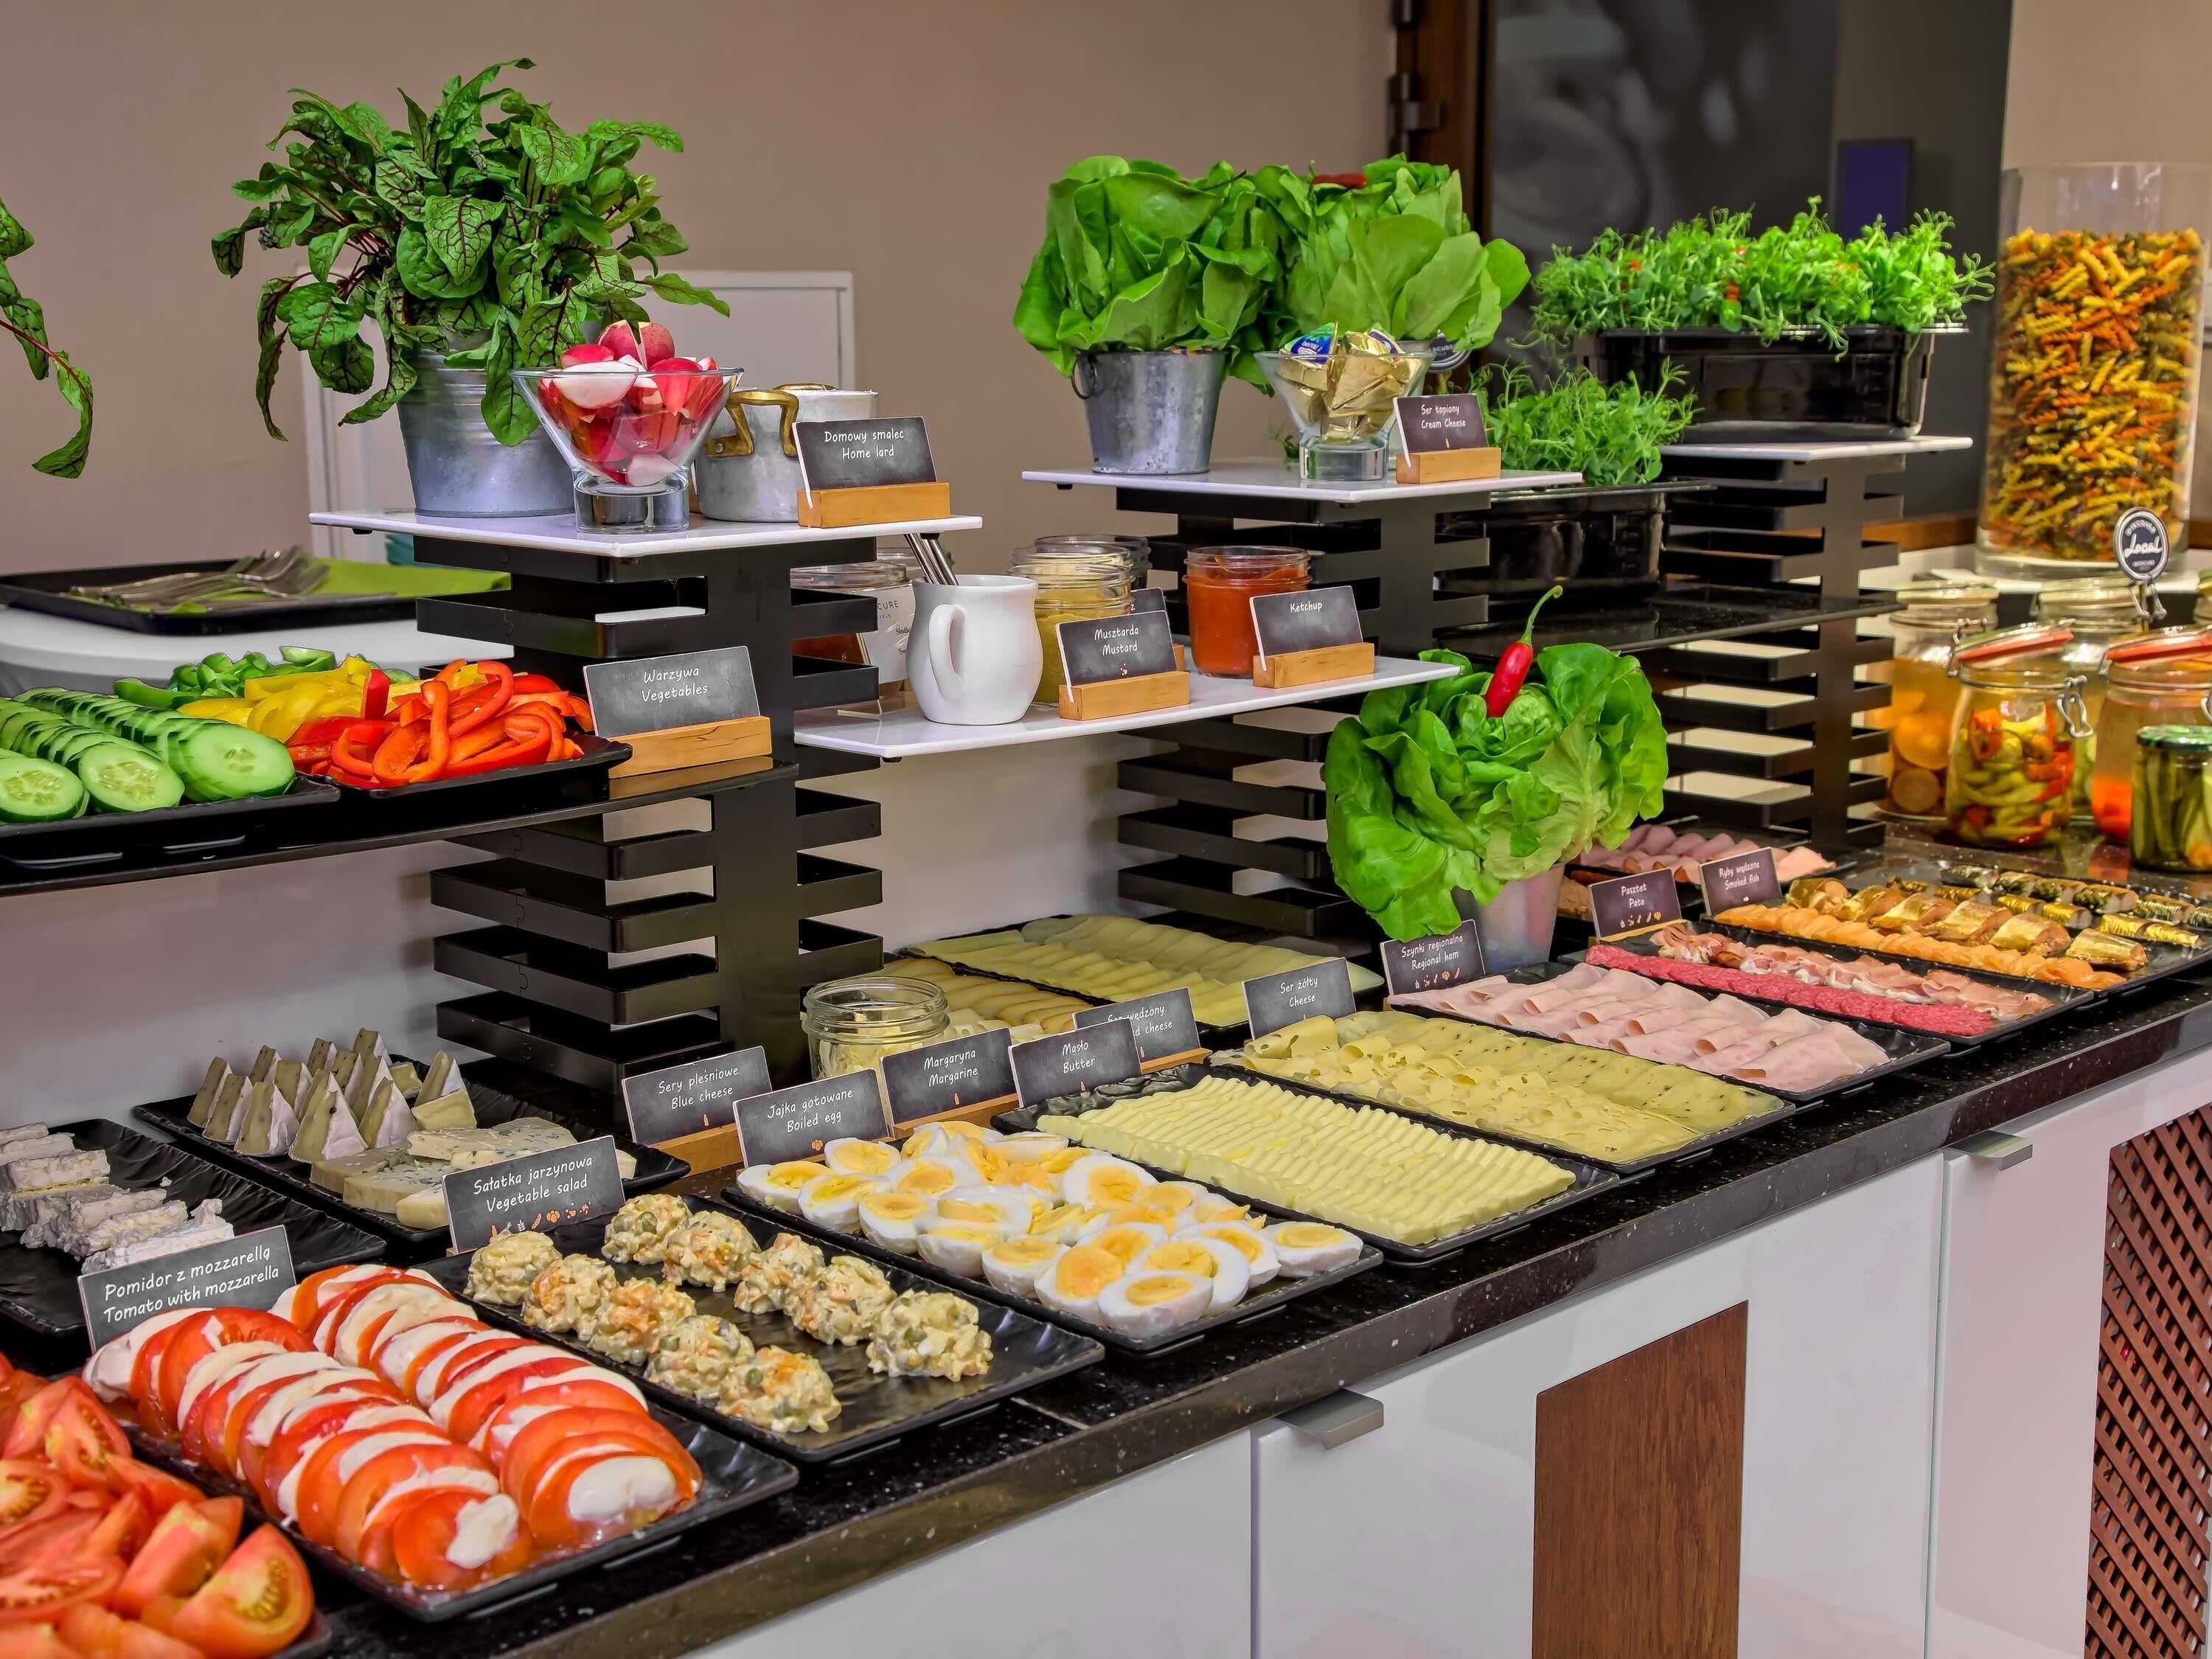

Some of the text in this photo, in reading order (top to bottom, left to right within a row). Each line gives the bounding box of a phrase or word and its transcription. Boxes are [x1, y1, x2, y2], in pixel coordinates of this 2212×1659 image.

[1421, 404, 1460, 415] Ser topiony
[1422, 418, 1466, 429] Cream Cheese
[824, 428, 904, 443] Domowy smalec
[842, 445, 894, 459] Home lard
[877, 600, 899, 610] CURE
[1290, 600, 1322, 613] Ketchup
[1094, 624, 1138, 641] Musztarda
[1102, 641, 1138, 655] Mustard
[644, 667, 699, 684] Warzywa
[641, 684, 708, 703] Vegetables
[1719, 867, 1733, 878] Ryby
[1621, 883, 1647, 897] Pasztet
[1725, 873, 1760, 890] Smoked fish
[1402, 934, 1464, 958] Szynki regionalne
[1411, 950, 1459, 970] Regional ham
[1280, 975, 1318, 994] Ser żółty
[1289, 995, 1316, 1007] Cheese
[1145, 1020, 1173, 1034] cheese
[1062, 1040, 1089, 1056] Masło
[924, 1049, 976, 1070] Margaryna
[1062, 1057, 1096, 1074] Butter
[658, 1066, 740, 1094] Sery pleśniowe
[928, 1067, 978, 1088] Margarine
[672, 1085, 734, 1110] Blue cheese
[767, 1089, 854, 1119] Jajka gotowane
[787, 1110, 842, 1133] Boiled egg
[473, 1156, 593, 1195] Sałatka jarzynowa
[486, 1173, 588, 1213] Vegetable salad
[105, 1273, 173, 1301] Pomidor
[176, 1270, 186, 1281] z
[103, 1265, 279, 1324] Tomato with mozzarella
